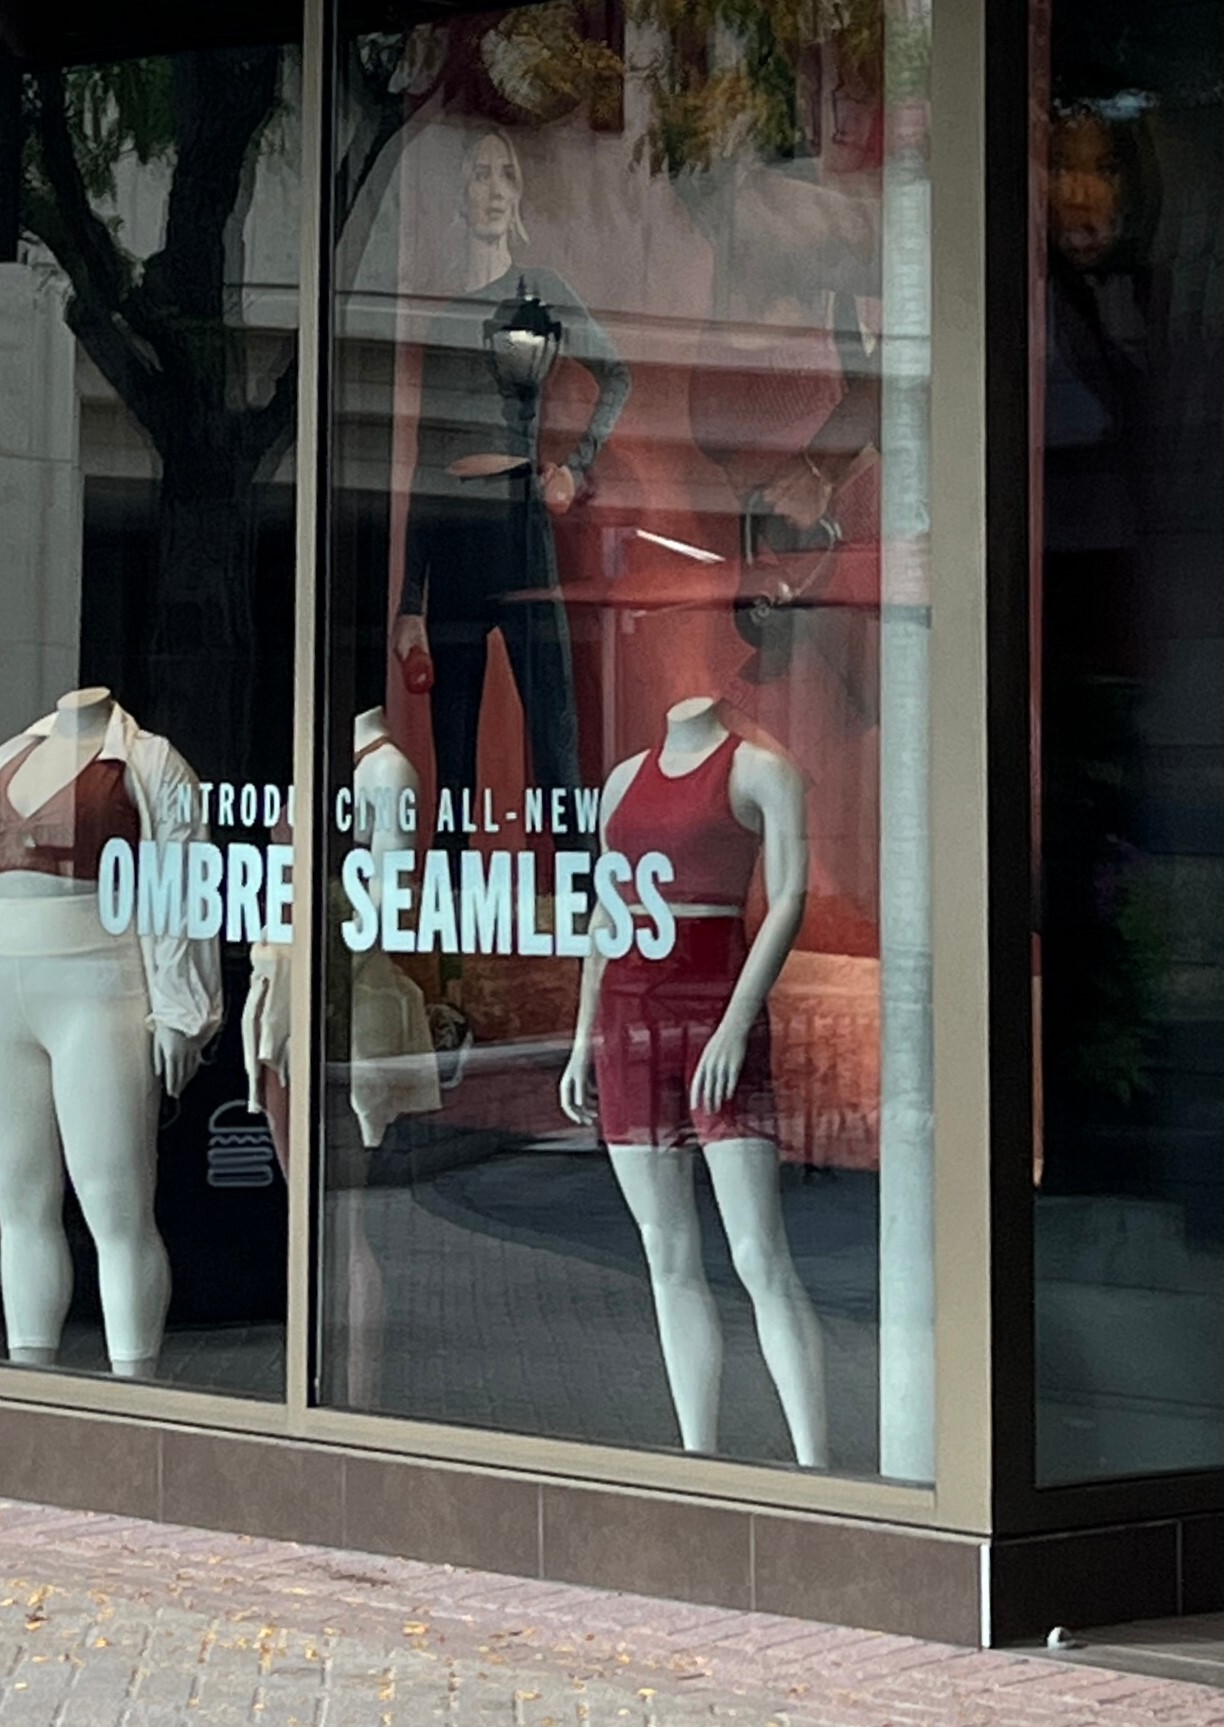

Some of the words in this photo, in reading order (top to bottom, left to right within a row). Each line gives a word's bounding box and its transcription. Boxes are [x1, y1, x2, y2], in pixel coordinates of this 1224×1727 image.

[436, 786, 601, 834] ALL-NEW
[97, 836, 295, 945] OMBRE
[340, 847, 676, 960] SEAMLESS
